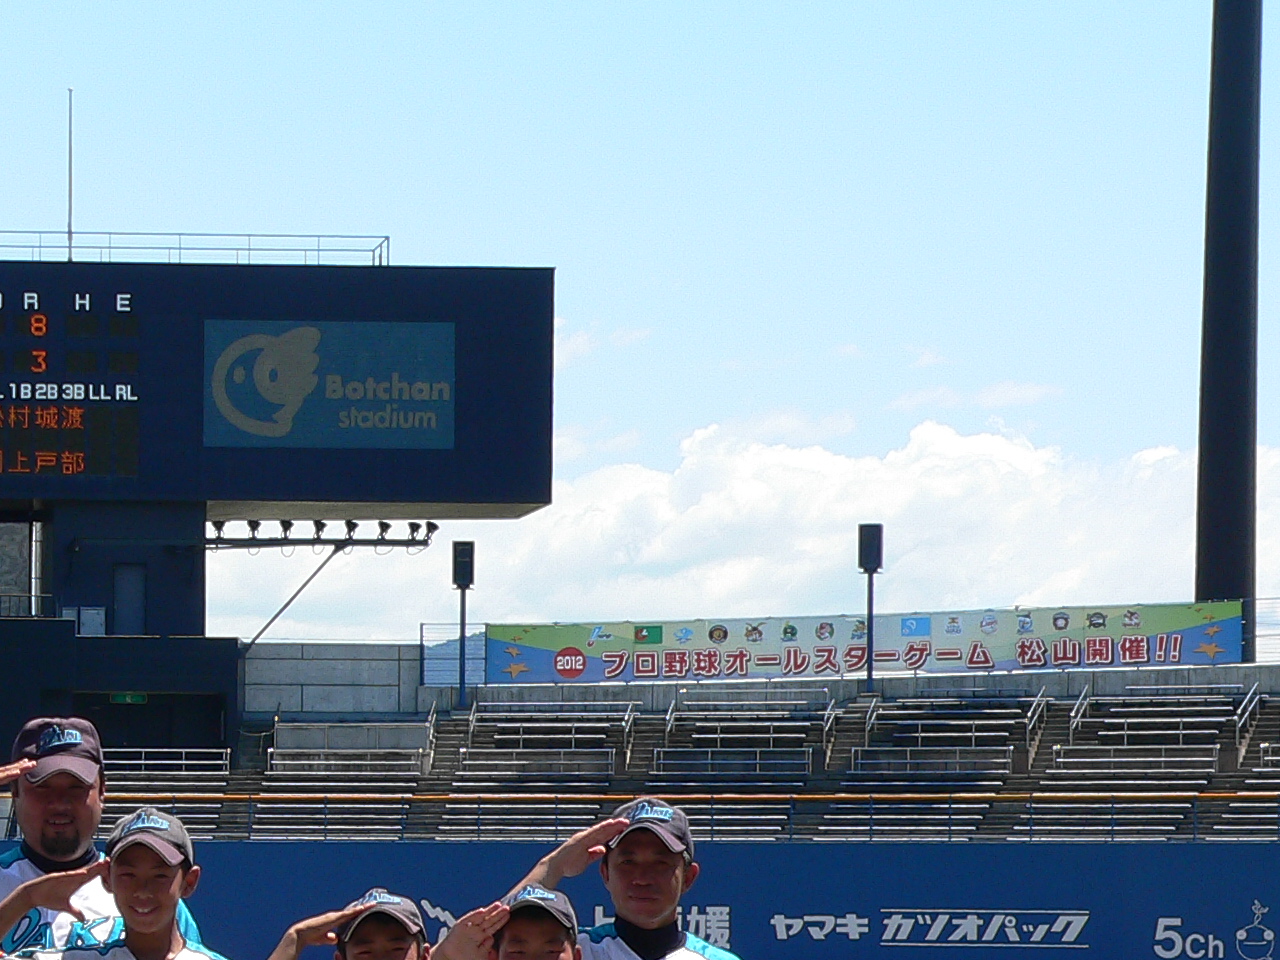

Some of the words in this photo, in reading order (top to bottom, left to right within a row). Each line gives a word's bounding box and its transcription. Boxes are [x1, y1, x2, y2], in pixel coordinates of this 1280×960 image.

[24, 293, 38, 309] R
[75, 294, 90, 310] H
[117, 294, 131, 311] E
[30, 314, 46, 336] 8
[31, 351, 46, 372] 3
[10, 383, 31, 398] 1B
[36, 384, 58, 399] 2B
[62, 384, 84, 399] 3B
[89, 384, 111, 400] LL
[116, 385, 137, 400] RL
[326, 373, 450, 400] Botchan
[339, 405, 437, 428] stadium
[9, 405, 30, 472] 村上
[35, 406, 58, 473] 城戸
[62, 406, 84, 474] 渡部
[556, 656, 584, 669] 2012
[602, 641, 995, 678] プロ野球オールスターゲーム
[1016, 633, 1182, 666] 松山開催!!
[770, 913, 869, 941] ヤマキ
[881, 913, 1089, 943] カツオパック
